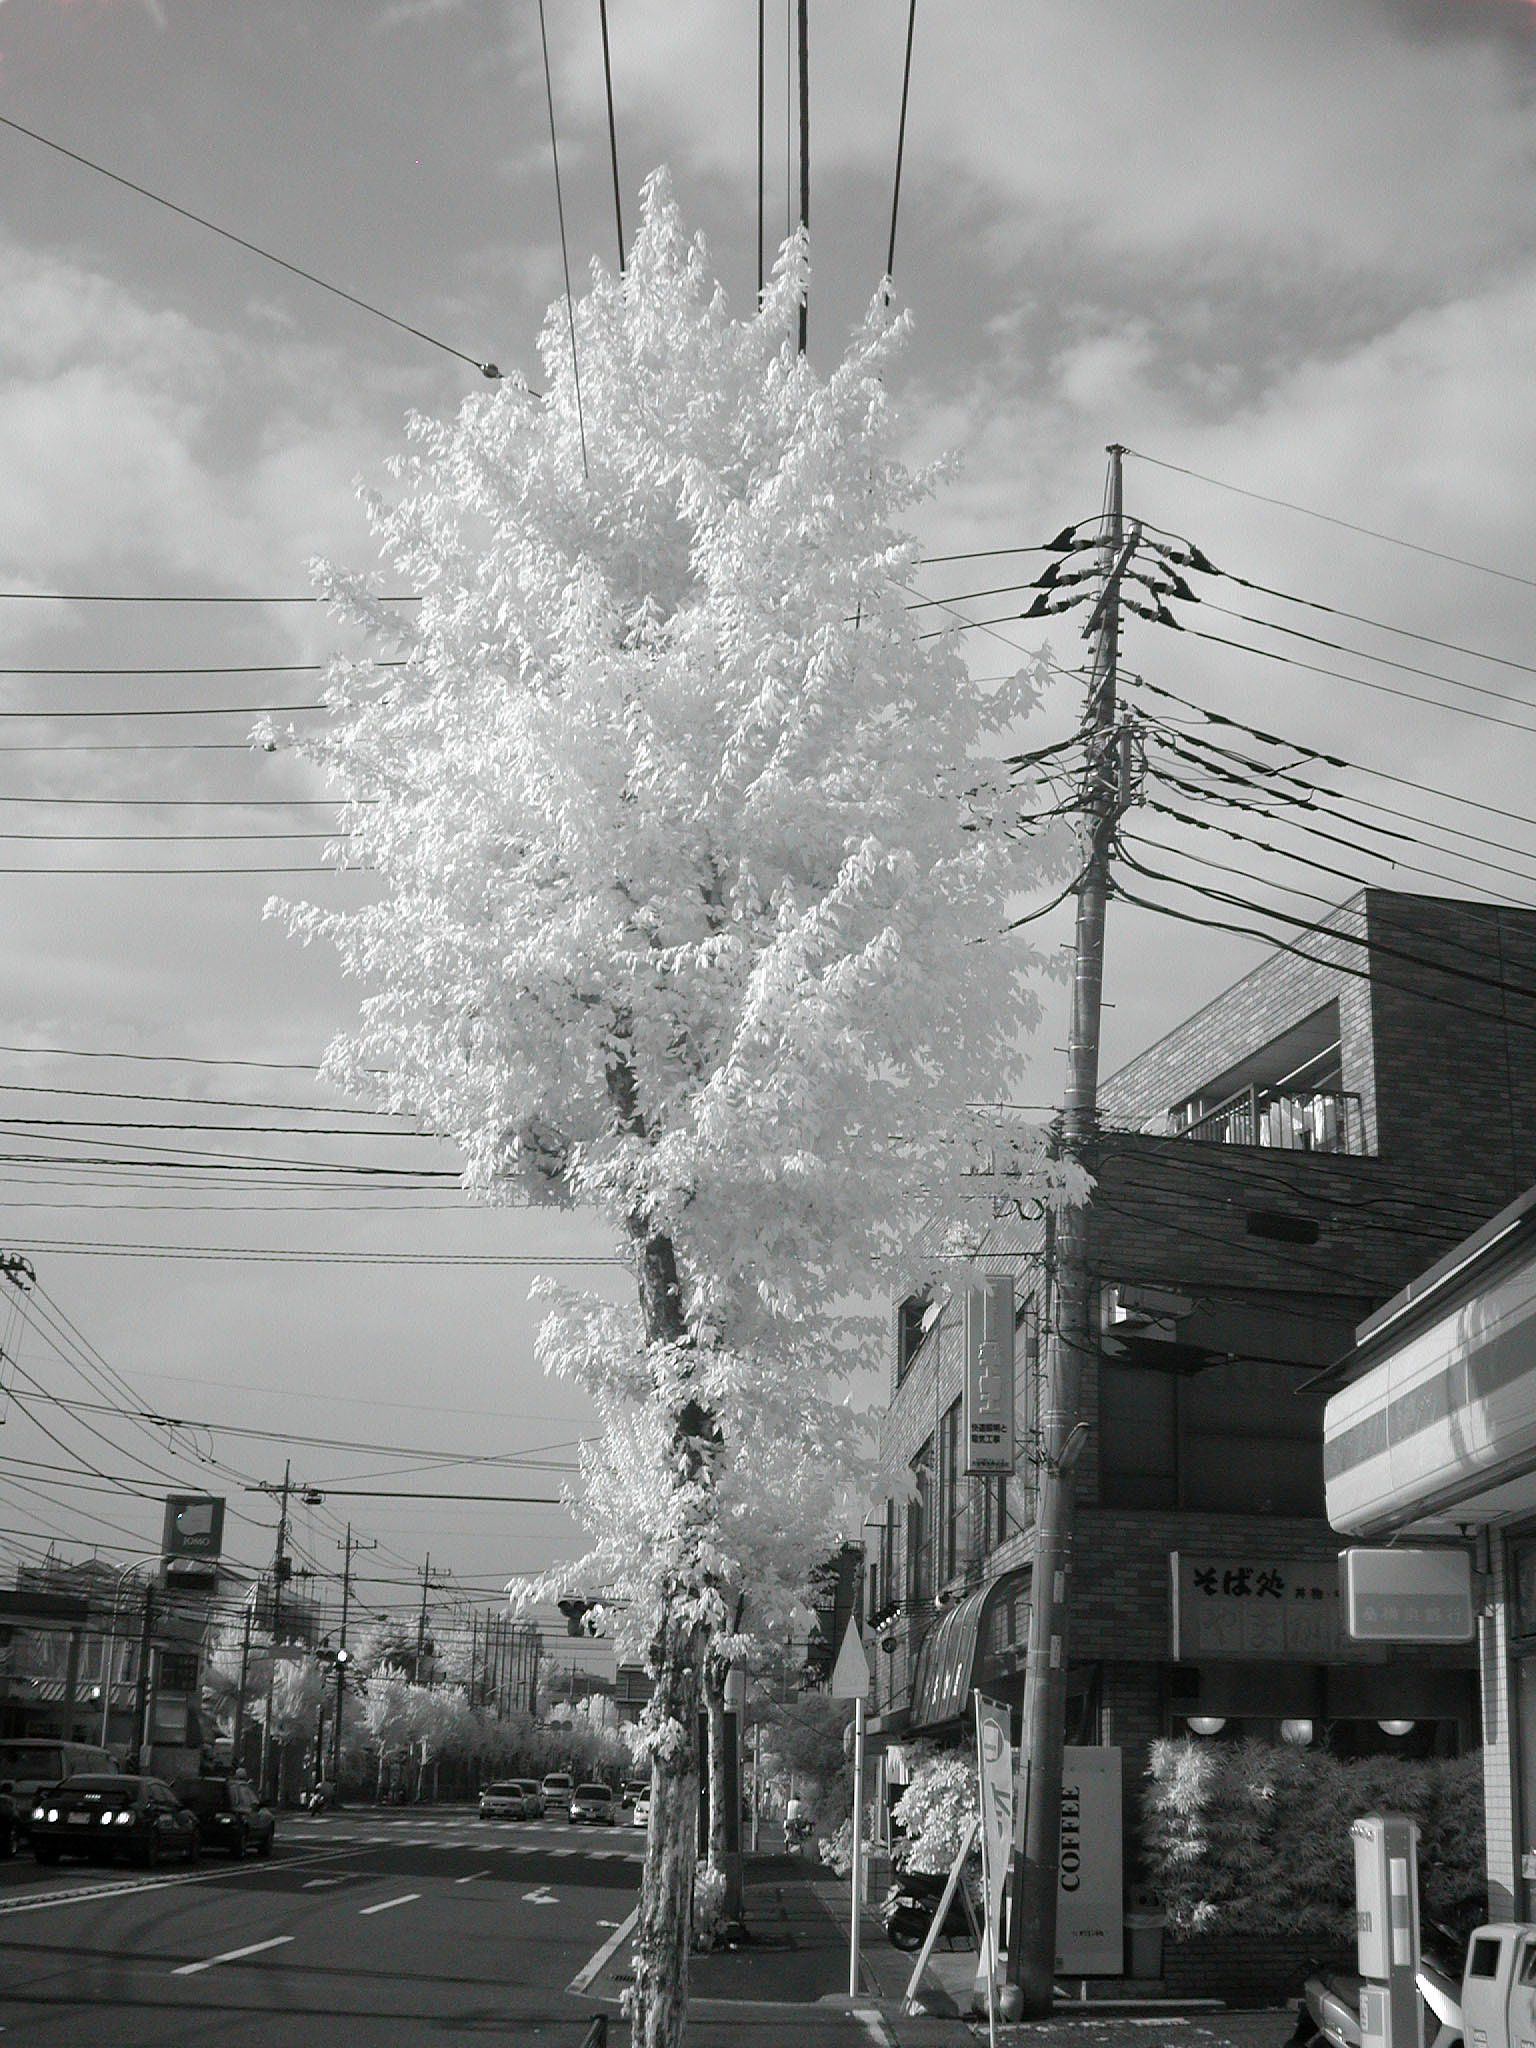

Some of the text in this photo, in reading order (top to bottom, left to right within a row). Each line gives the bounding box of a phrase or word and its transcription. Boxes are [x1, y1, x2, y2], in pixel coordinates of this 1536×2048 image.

[1193, 1566, 1286, 1599] そば処
[1060, 1785, 1081, 1892] COFFEE
